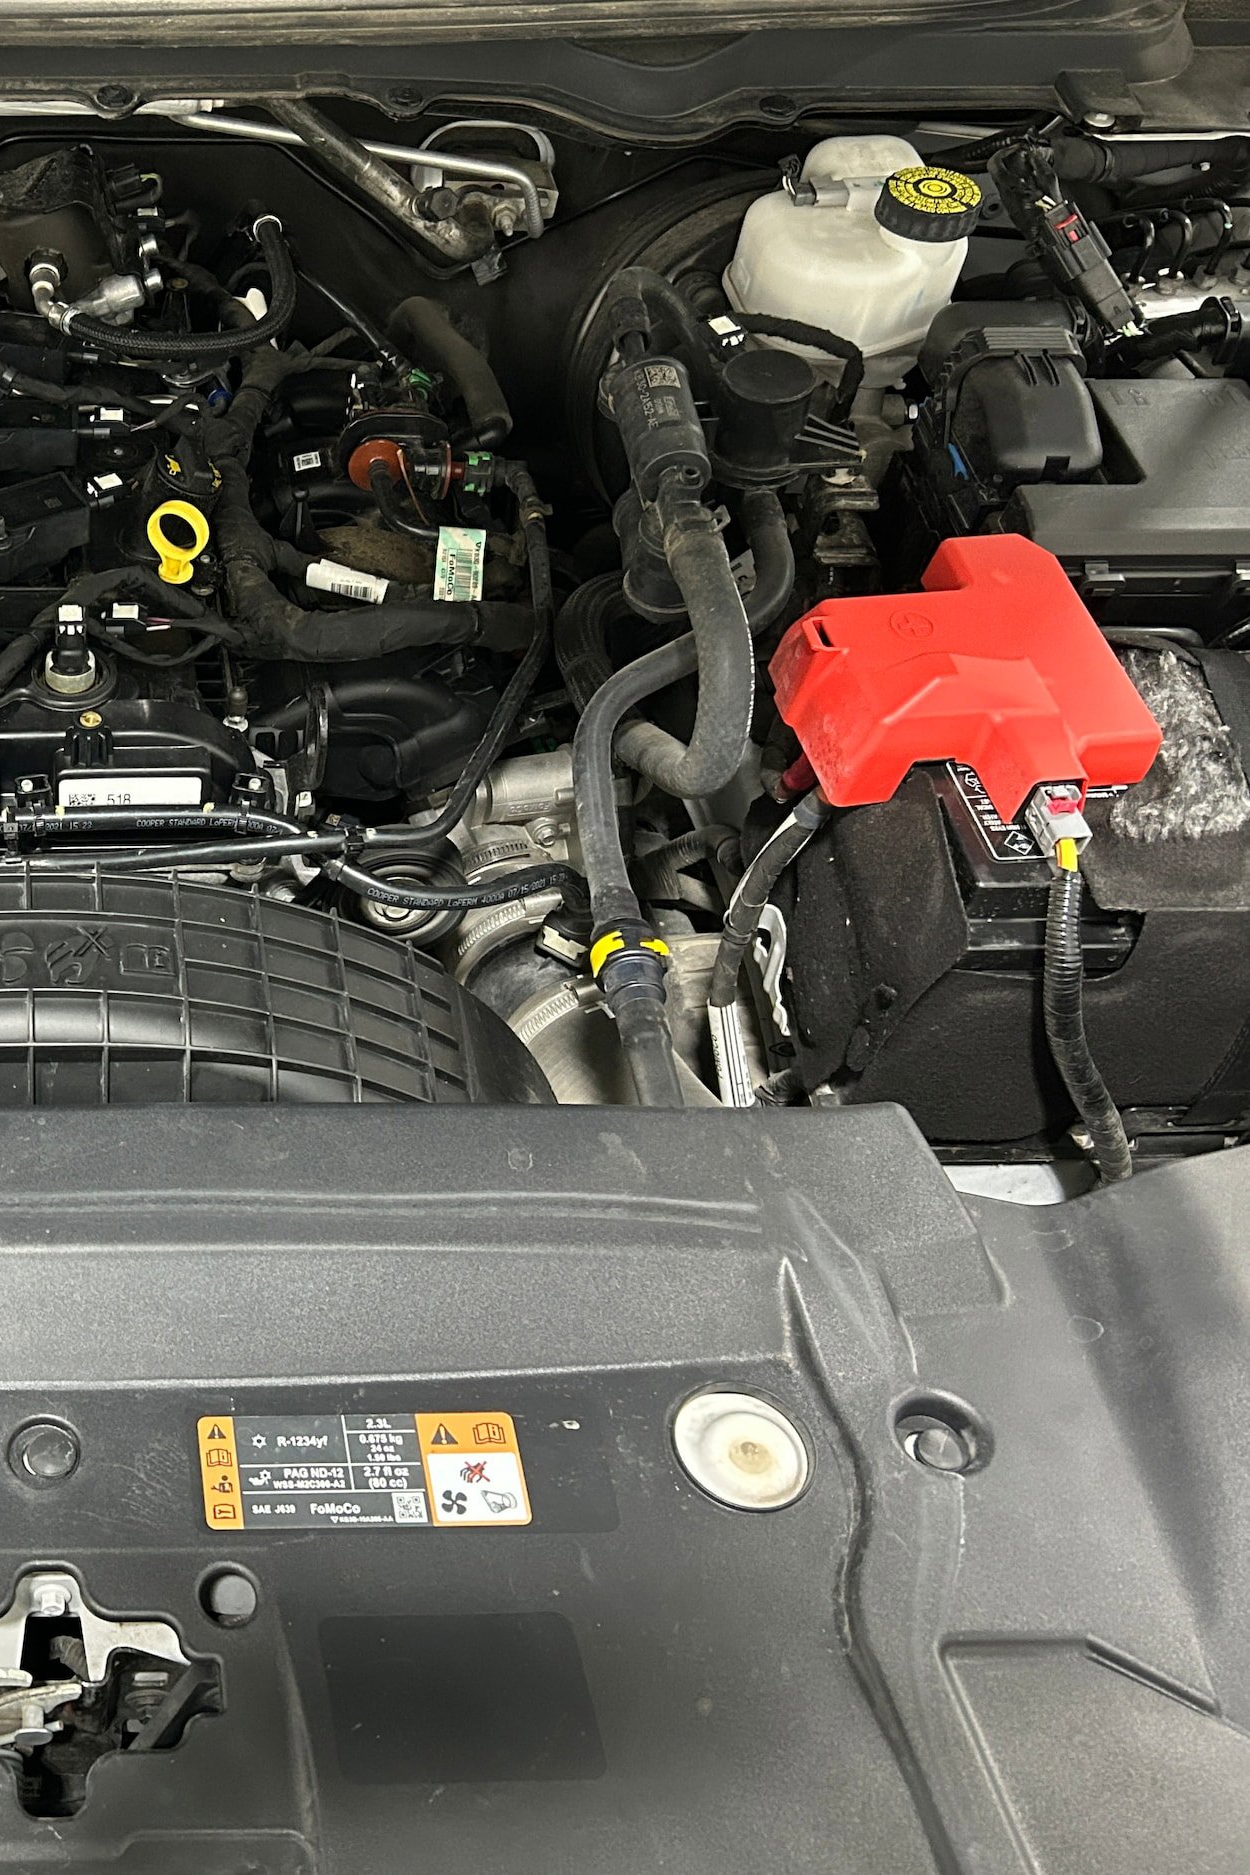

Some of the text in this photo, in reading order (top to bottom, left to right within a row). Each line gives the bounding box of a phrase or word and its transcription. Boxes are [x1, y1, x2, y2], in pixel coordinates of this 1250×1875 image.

[446, 554, 456, 596] FoMoCo
[136, 818, 165, 828] COOPER
[169, 818, 206, 827] STANDARD
[367, 887, 399, 903] COOPER
[402, 896, 444, 907] STANDARD
[365, 1418, 392, 1430] 2.3L
[276, 1435, 329, 1449] R-1234yf
[388, 1433, 404, 1446] kg
[283, 1467, 345, 1479] PAG ND-12
[363, 1466, 381, 1477] 2.7
[393, 1467, 410, 1477] oz
[388, 1477, 408, 1490] cc)
[252, 1504, 272, 1515] SAE
[310, 1502, 361, 1515] FoMoCo
